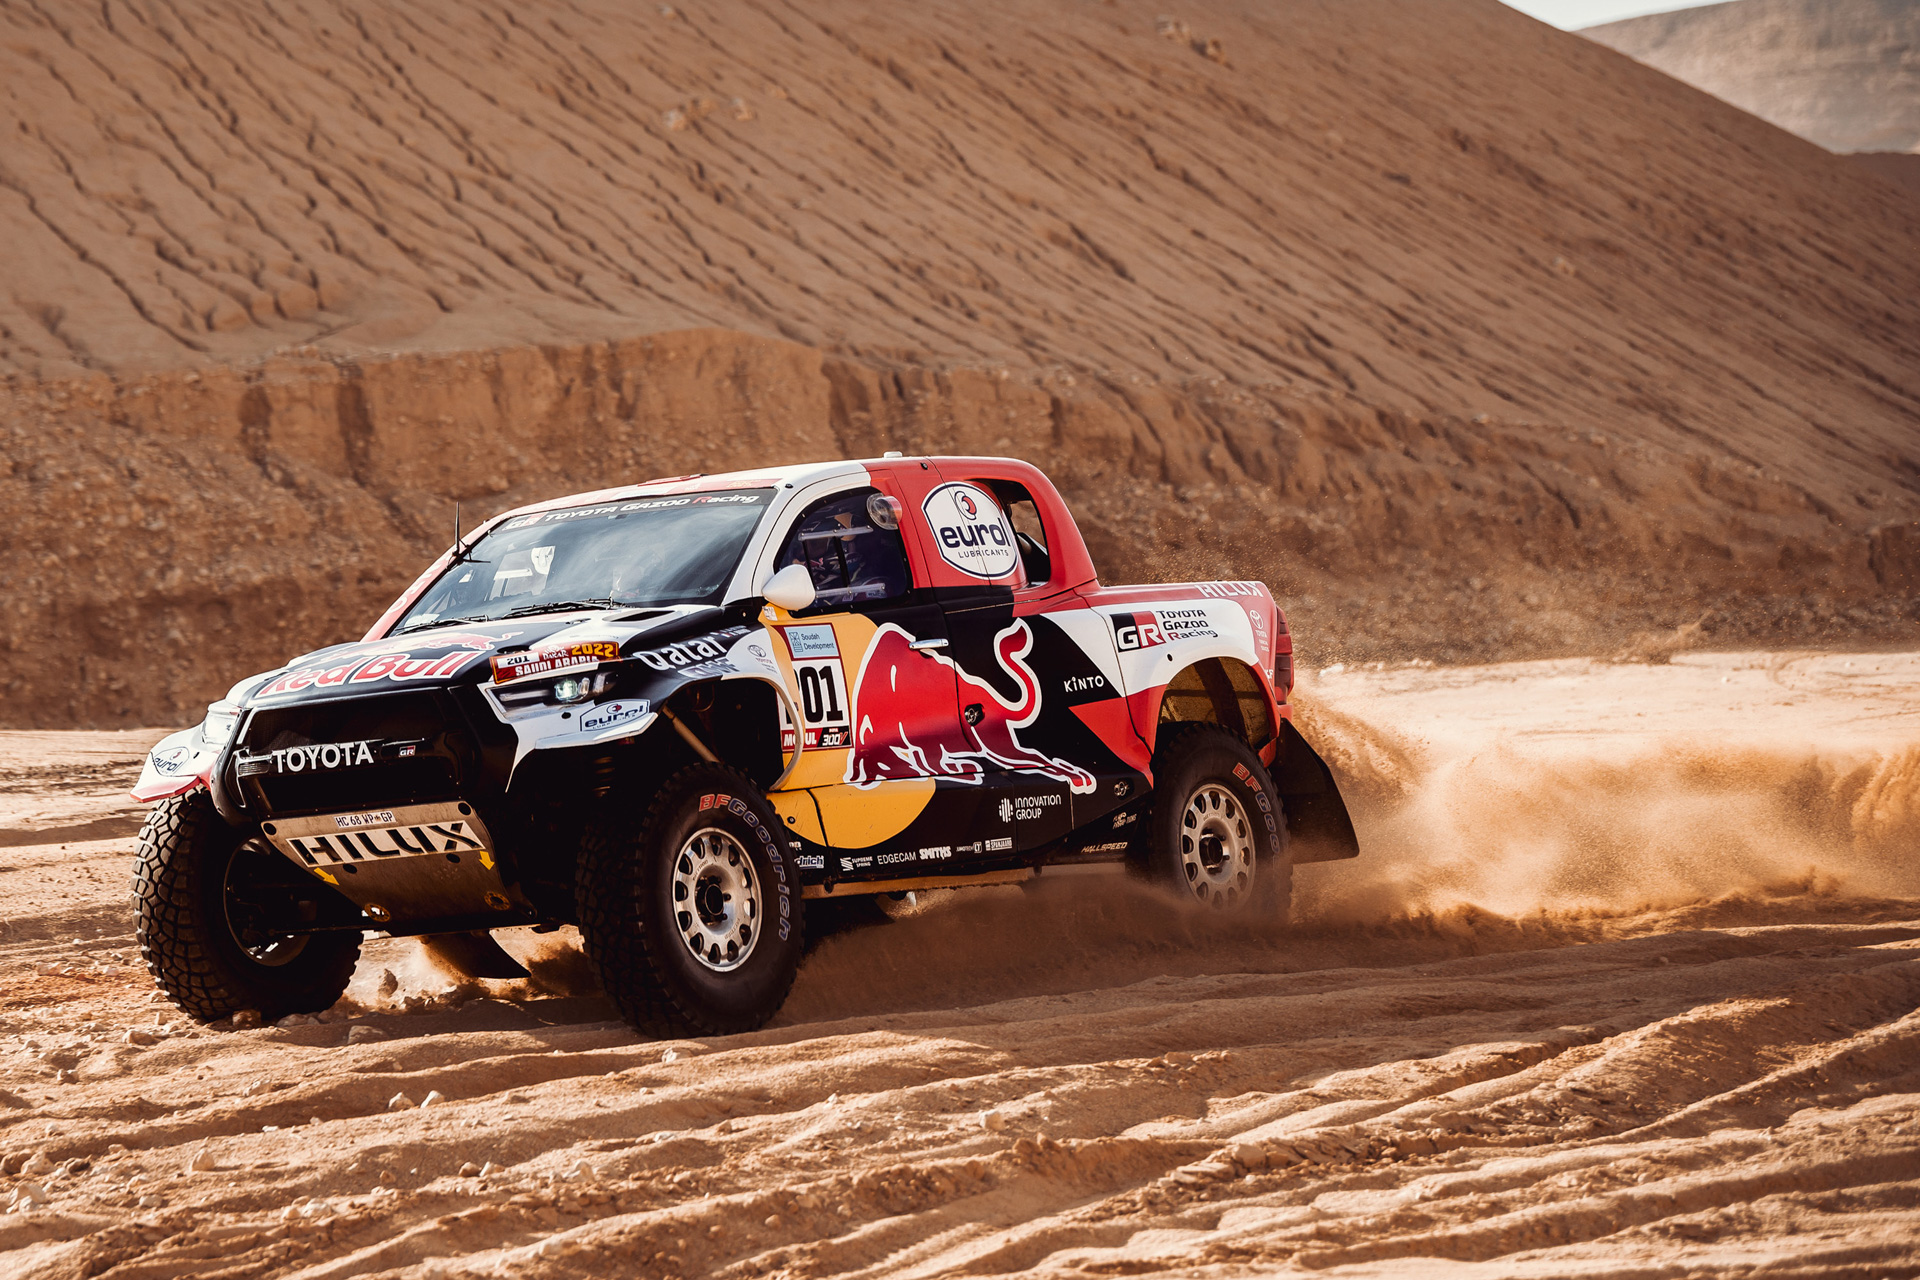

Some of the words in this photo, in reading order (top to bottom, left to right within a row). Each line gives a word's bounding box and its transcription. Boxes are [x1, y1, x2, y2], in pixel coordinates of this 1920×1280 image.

[544, 506, 618, 522] TOYOTA
[620, 498, 690, 512] GAZOO
[692, 494, 760, 504] Racing
[940, 517, 1011, 549] eurol
[958, 549, 1009, 559] LUBRICANTS
[1194, 582, 1264, 598] HILUX
[1156, 609, 1206, 620] TOYOTA
[1163, 620, 1209, 631] GAZOO
[801, 633, 821, 641] Soudah
[1117, 623, 1166, 650] GR
[1168, 629, 1218, 641] Racing
[571, 642, 614, 658] 2022
[632, 636, 728, 671] Qatar
[803, 642, 835, 651] Development
[506, 655, 530, 666] 201
[257, 657, 369, 697] Red
[351, 652, 485, 682] Bull
[785, 666, 844, 724] 01
[585, 705, 644, 728] eurol
[272, 741, 375, 773] TOYOTA
[399, 747, 415, 757] GR
[1015, 794, 1062, 808] INNOVATION
[335, 816, 350, 827] HC
[350, 815, 362, 826] 68
[362, 813, 375, 824] WP
[380, 811, 394, 823] GP
[1015, 808, 1043, 821] GROUP
[290, 822, 481, 865] HILUX
[1081, 842, 1128, 853] HALLSPEED
[852, 856, 873, 864] SUPREME
[877, 852, 917, 865] EDGECAM
[698, 793, 791, 941] BFGoodrich
